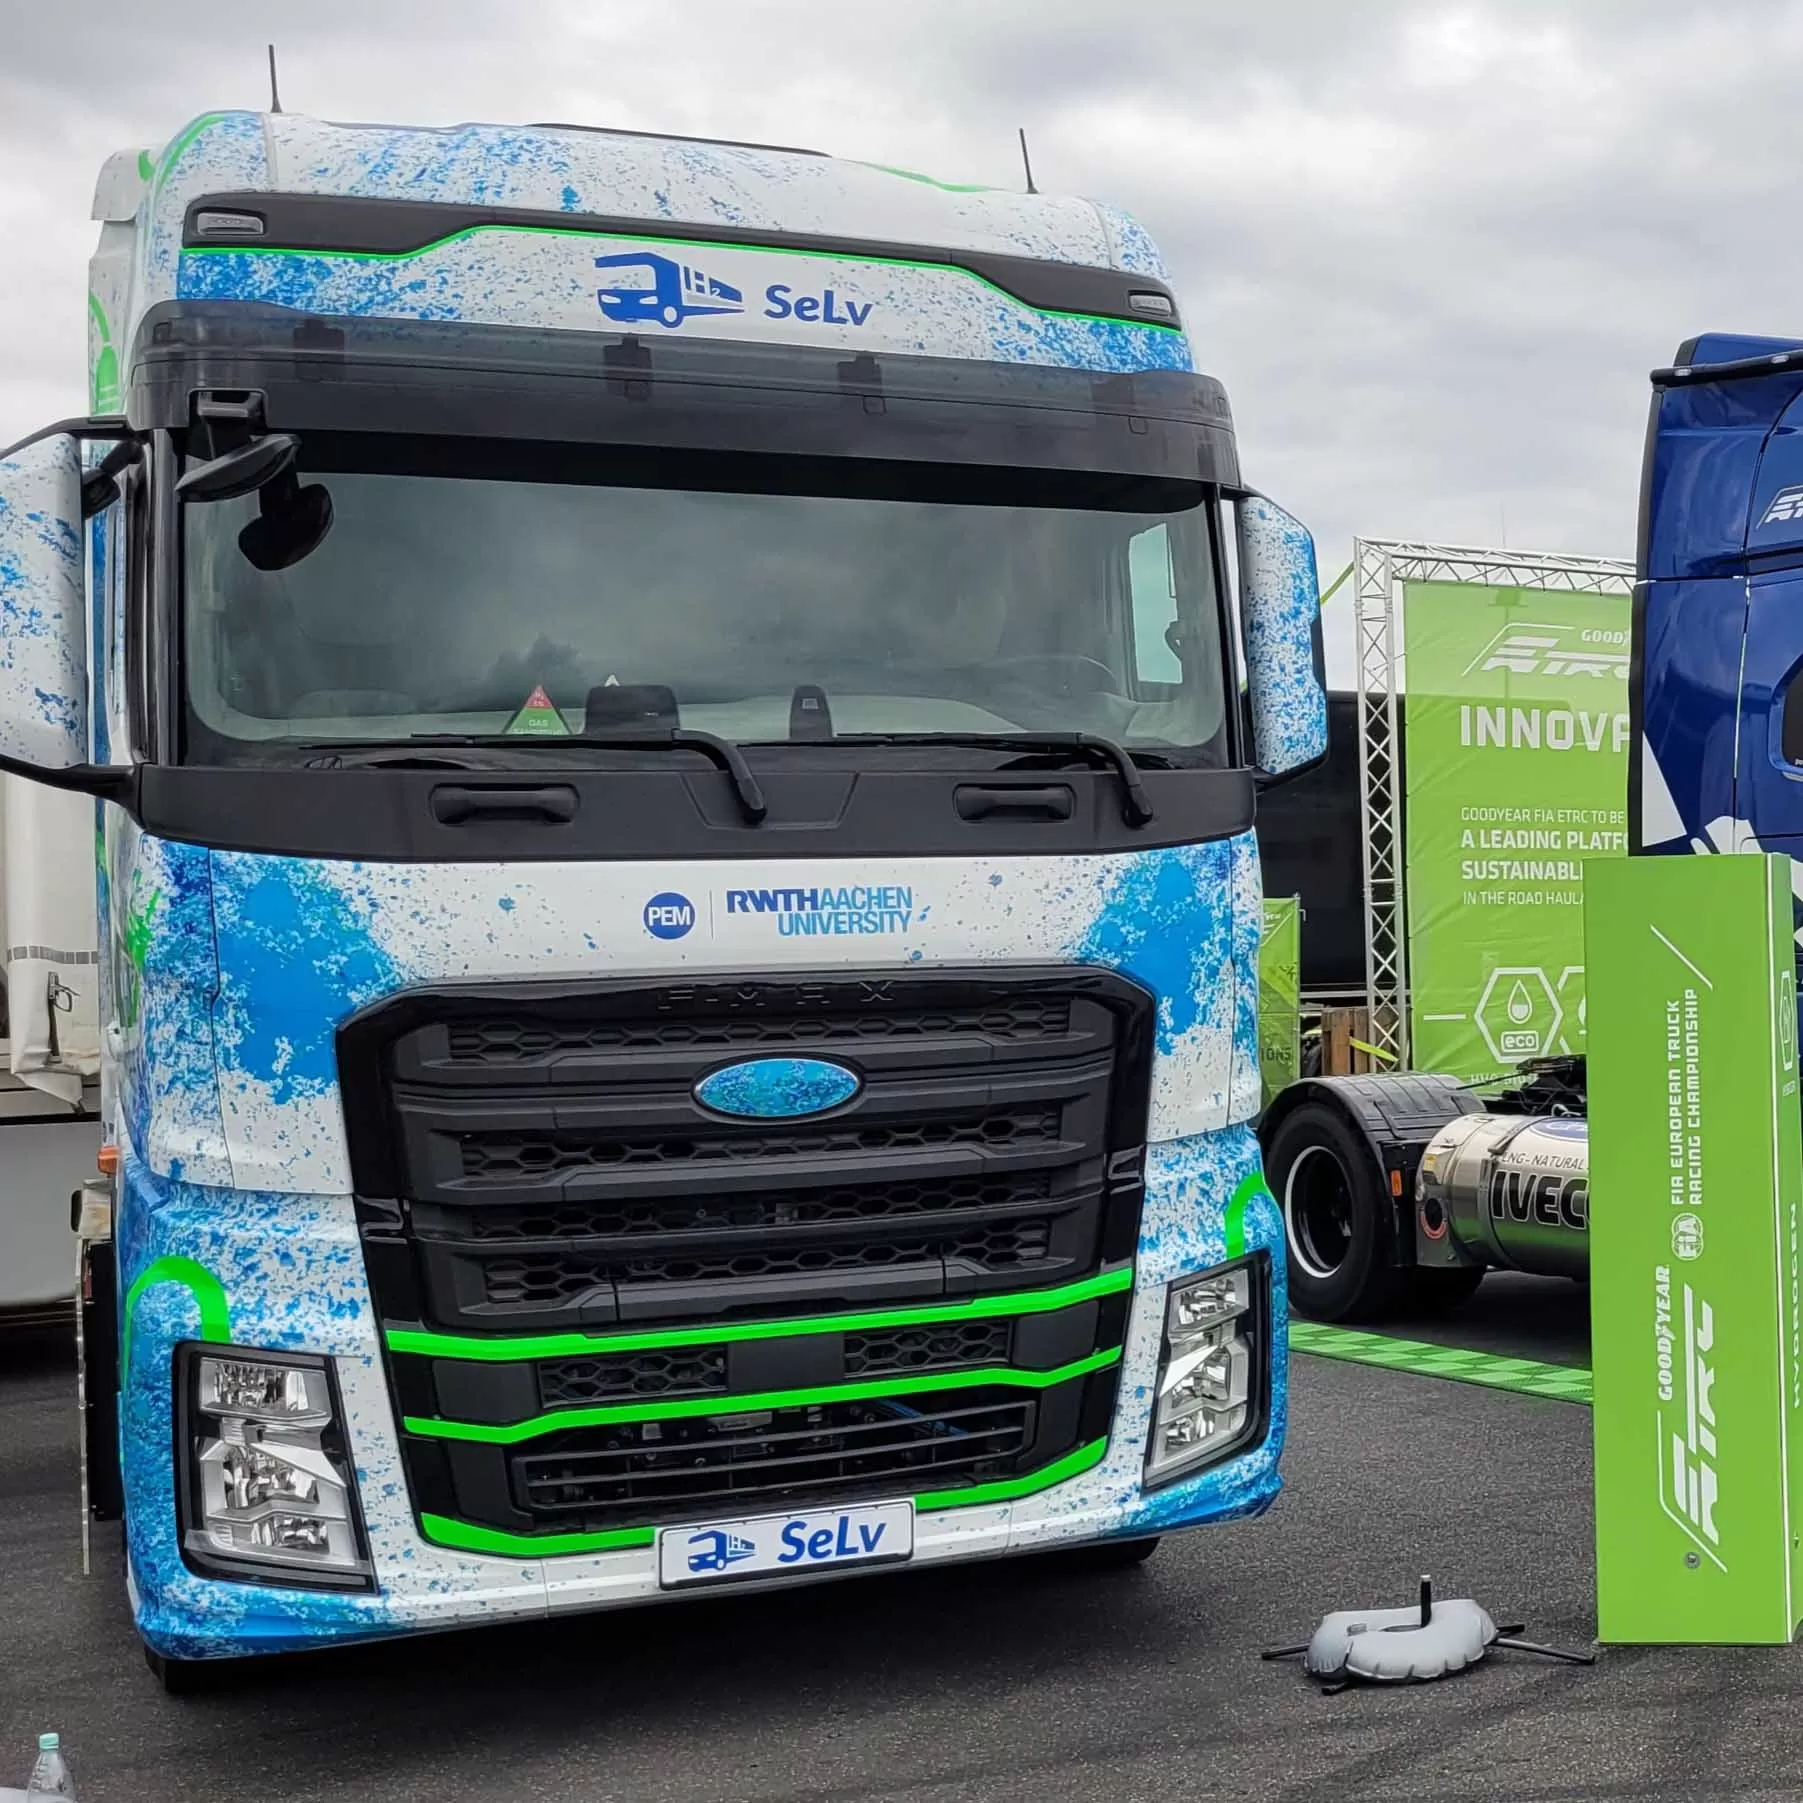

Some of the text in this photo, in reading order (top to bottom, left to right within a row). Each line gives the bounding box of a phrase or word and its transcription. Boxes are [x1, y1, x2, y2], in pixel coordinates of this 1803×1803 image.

[763, 284, 873, 326] SeLv
[1460, 806, 1625, 825] GOODYEAR FIA ETRC TO BE
[1460, 828, 1475, 848] A
[1479, 828, 1561, 849] LEADING
[648, 906, 692, 927] PEM
[1463, 891, 1476, 905] IN
[1478, 891, 1505, 905] THE
[1508, 891, 1543, 905] ROAD
[777, 910, 913, 936] UNIVERSITY
[1504, 1035, 1535, 1047] eco
[1666, 1000, 1684, 1205] FIA EUROPEAN TRUCK
[1684, 988, 1702, 1205] RACING CHAMPIONSHIP
[1490, 1169, 1589, 1230] IVEC
[1676, 1215, 1698, 1258] FIA
[1655, 1265, 1676, 1401] GOODYEAR
[777, 1516, 887, 1563] SeLv
